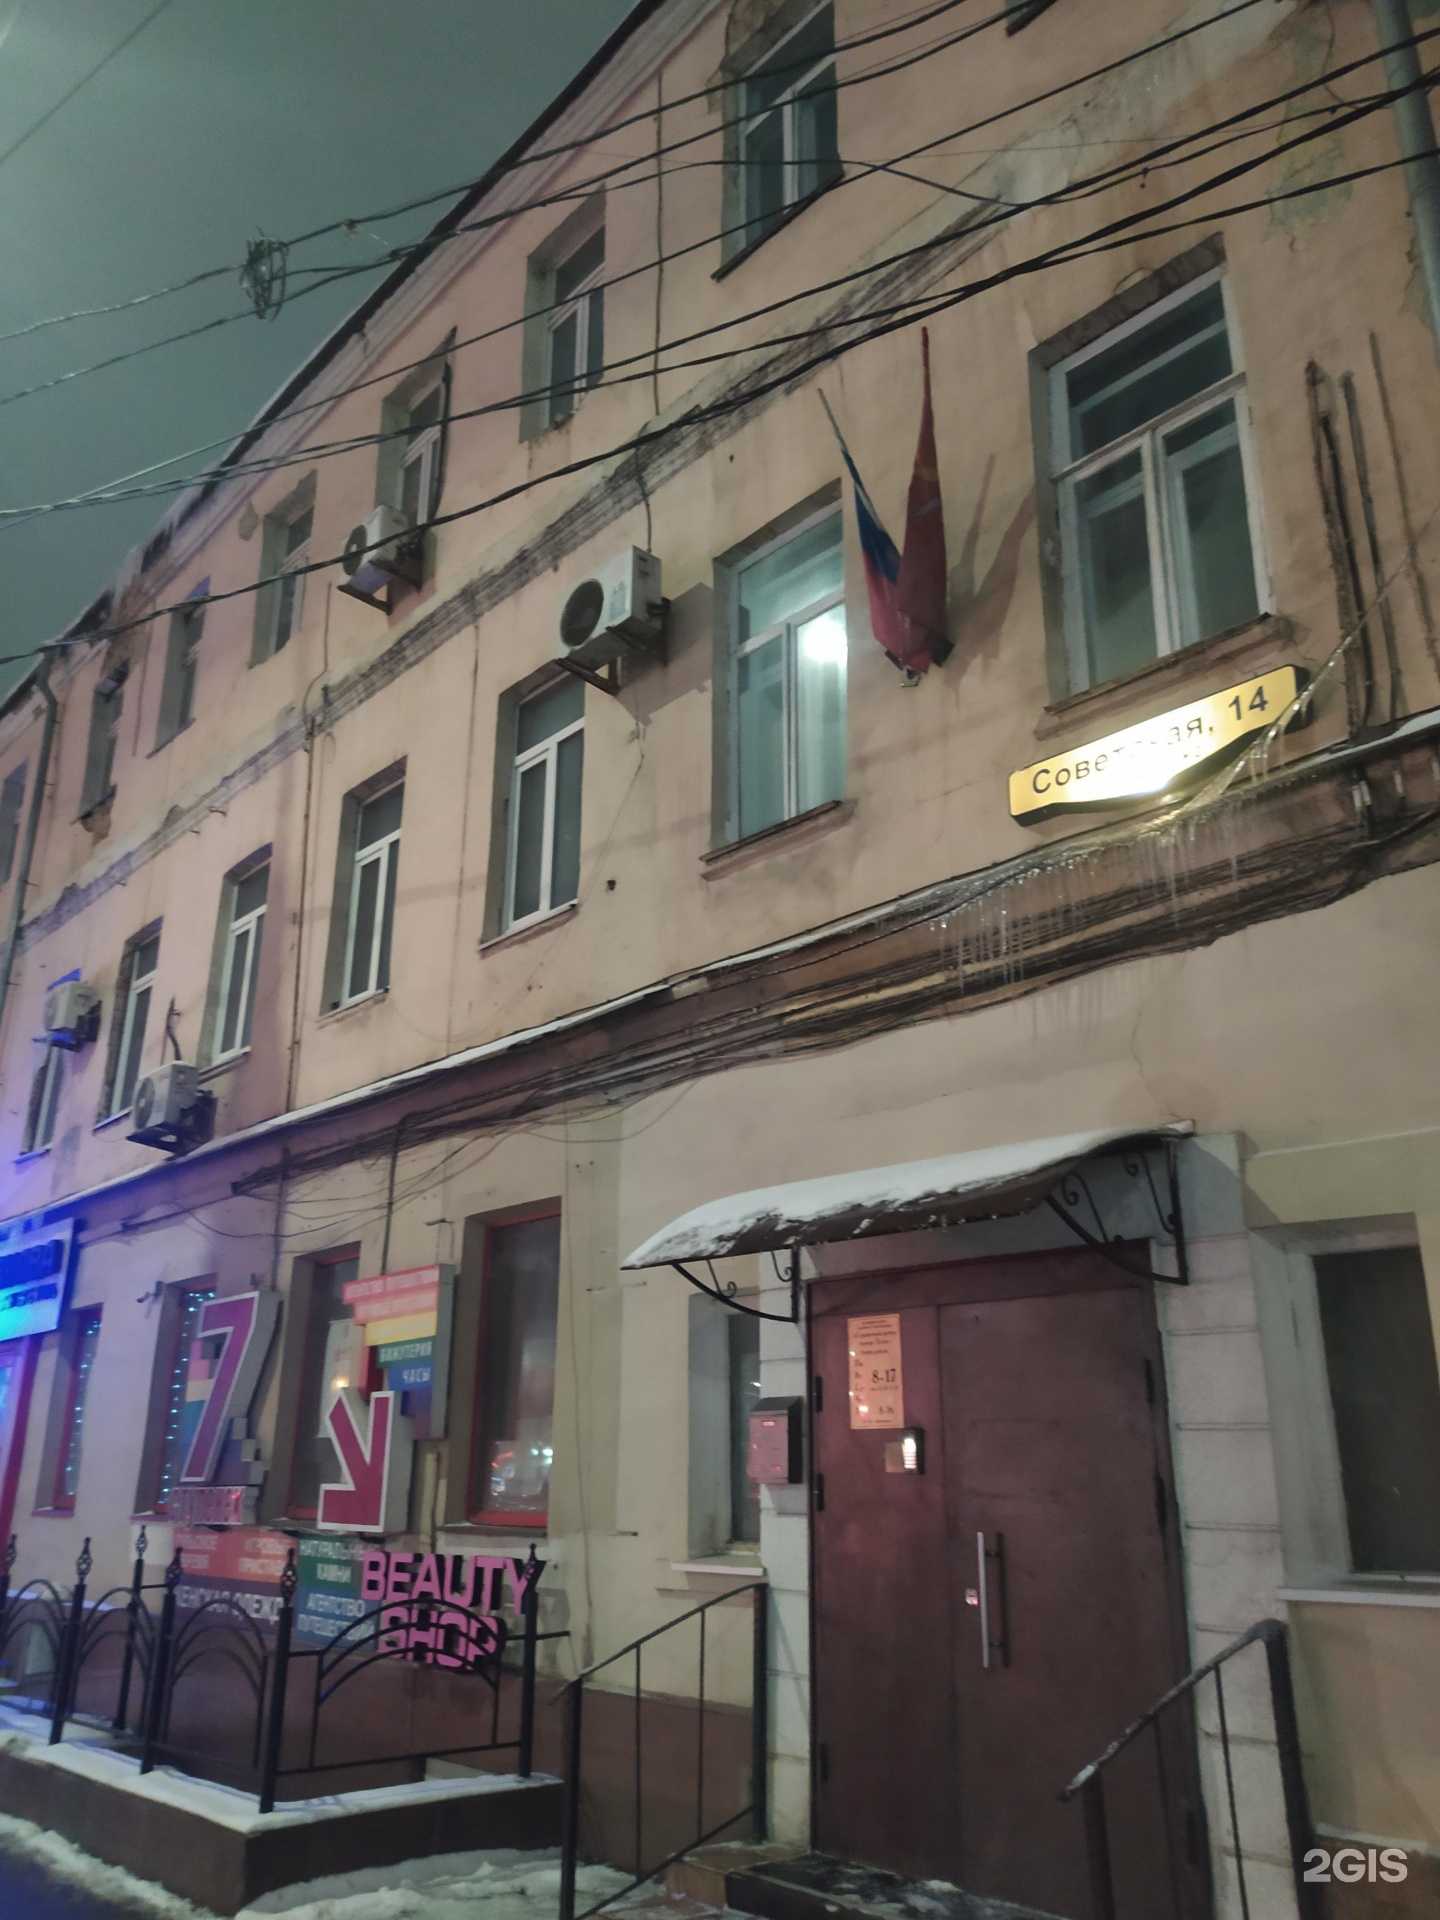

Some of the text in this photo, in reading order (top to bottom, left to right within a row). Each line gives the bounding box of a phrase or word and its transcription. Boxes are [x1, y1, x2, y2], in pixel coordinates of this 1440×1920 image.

[1032, 686, 1269, 795] Совеая, 14
[402, 1367, 432, 1384] ЧАСЫ
[361, 1551, 537, 1616] BEAUTY
[377, 1605, 499, 1668] SHOP
